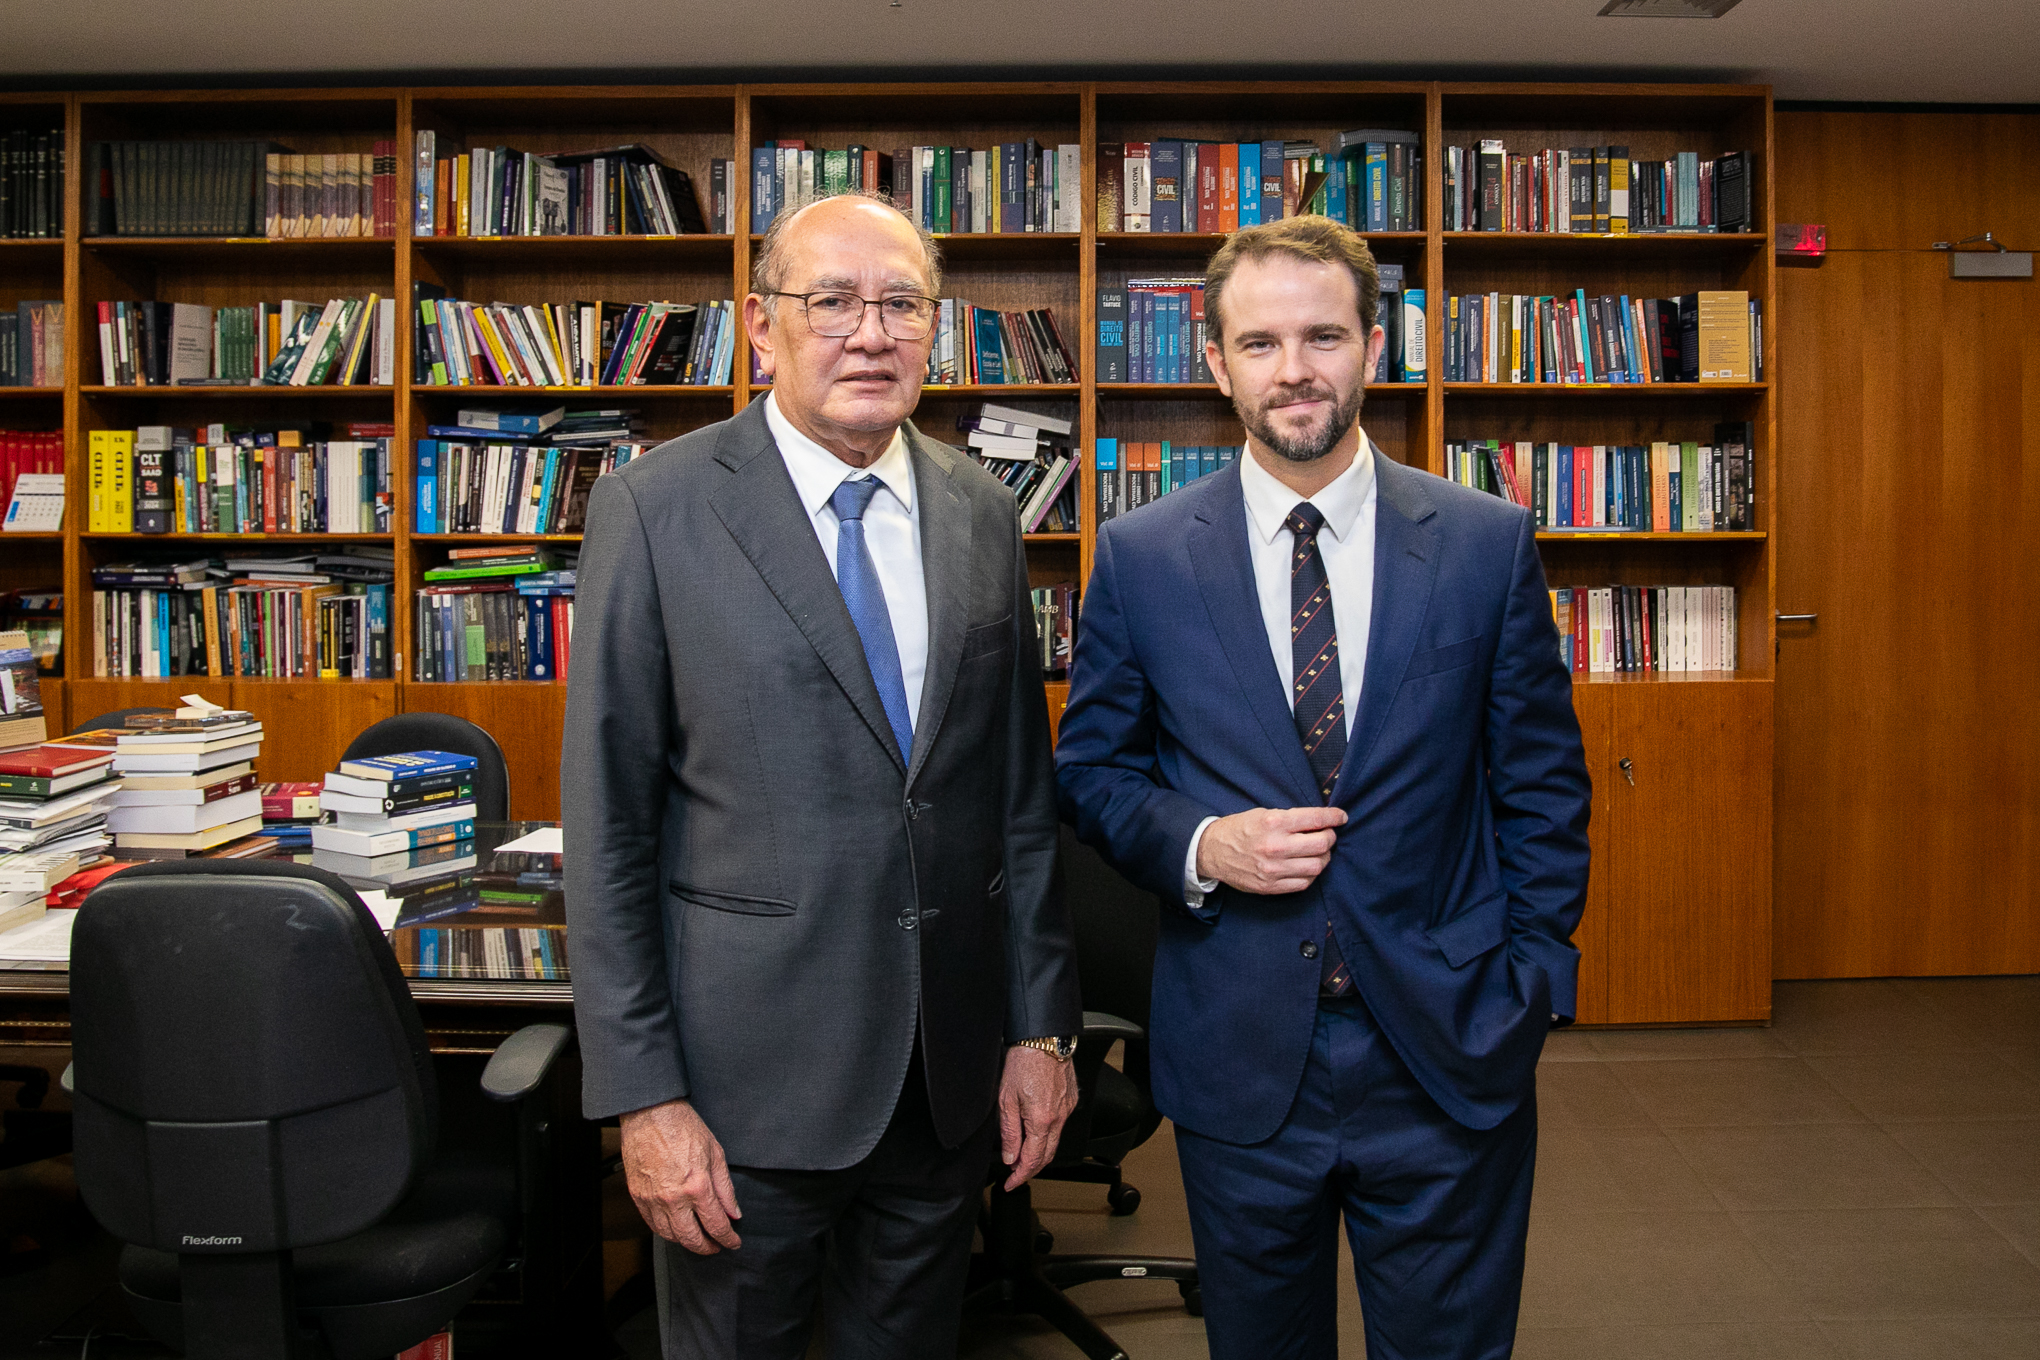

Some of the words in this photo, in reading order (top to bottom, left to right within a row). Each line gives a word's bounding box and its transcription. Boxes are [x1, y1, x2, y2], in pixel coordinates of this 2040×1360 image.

[1373, 167, 1382, 180] CIVIL
[1157, 185, 1175, 195] CIVIL
[1264, 183, 1281, 192] CIVIL
[1394, 178, 1402, 190] Civil
[1373, 181, 1381, 201] DIREITO
[1394, 190, 1402, 214] Direito
[1414, 318, 1423, 336] CIVIL
[1100, 332, 1124, 343] CIVIL
[1415, 336, 1423, 363] DIREITO
[140, 454, 162, 466] CLT
[182, 1236, 242, 1245] Flexform
